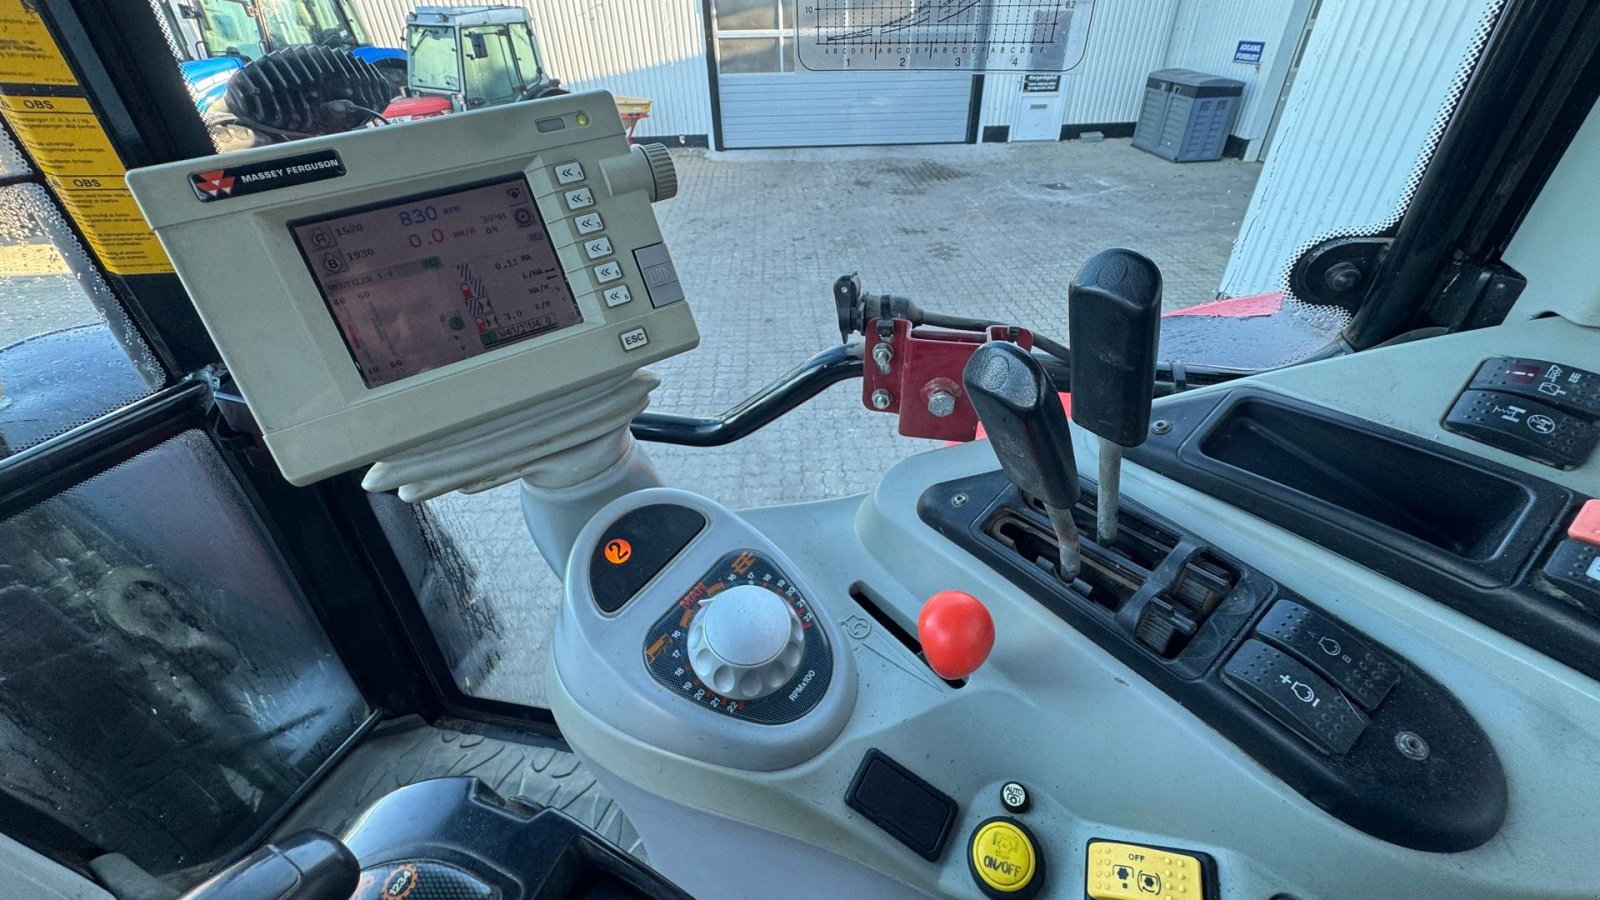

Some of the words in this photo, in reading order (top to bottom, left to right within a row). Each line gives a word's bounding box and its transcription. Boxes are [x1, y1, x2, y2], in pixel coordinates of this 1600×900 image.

[805, 6, 813, 14] 10
[846, 58, 850, 66] 1
[900, 58, 905, 66] 2
[955, 58, 960, 66] 3
[1012, 57, 1018, 66] 4
[23, 100, 54, 110] OBS
[240, 169, 283, 183] MASSEY
[286, 159, 339, 175] FERGUSON
[73, 179, 101, 187] OBS
[399, 206, 437, 226] 830
[335, 224, 363, 236] 1520
[407, 228, 444, 248] 0.0
[328, 258, 338, 268] B
[345, 248, 375, 261] 1930
[495, 259, 519, 270] 0.11
[334, 297, 345, 306] 40
[358, 291, 370, 299] 60
[625, 334, 644, 346] ESC
[608, 541, 629, 560] 2
[802, 612, 812, 622] 22
[671, 631, 681, 639] 16
[672, 650, 681, 659] 17
[1342, 654, 1352, 663] B
[674, 668, 684, 677] 18
[683, 681, 692, 691] 19
[788, 669, 815, 702] RPMx100
[694, 688, 705, 701] 20
[710, 697, 720, 708] 21
[726, 701, 738, 713] 22
[1005, 785, 1023, 796] AUTO
[1128, 852, 1145, 862] OFF
[983, 855, 1021, 877] ON/OFF
